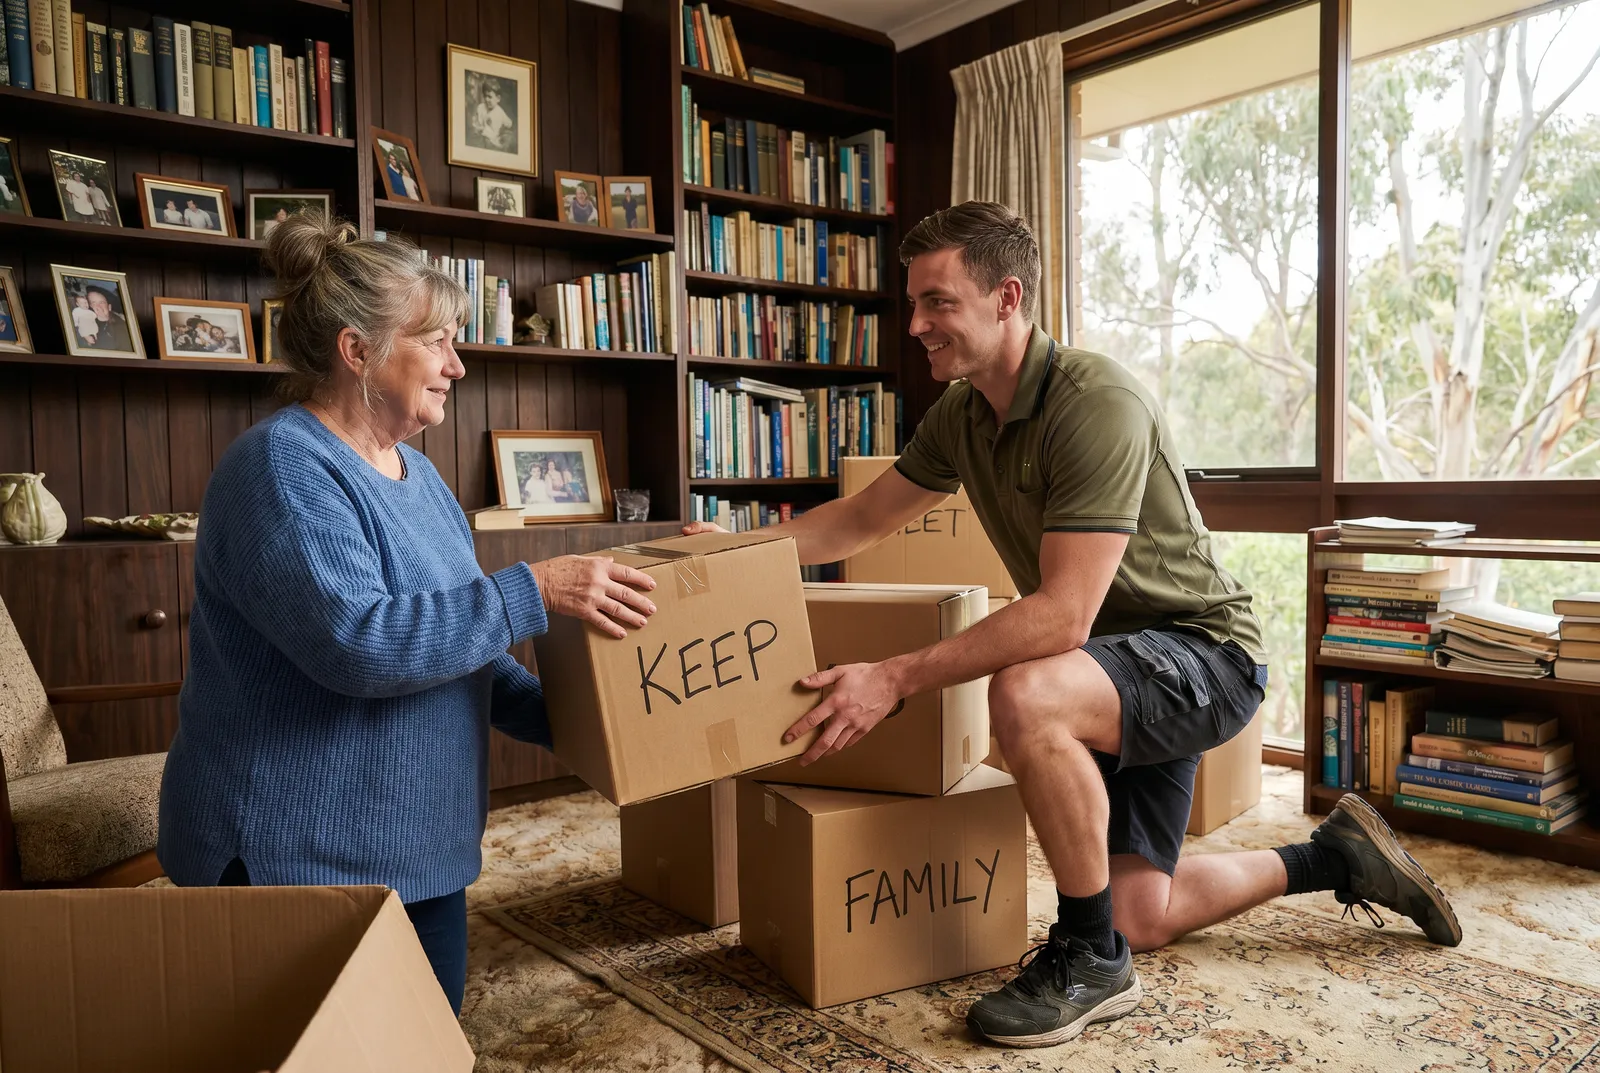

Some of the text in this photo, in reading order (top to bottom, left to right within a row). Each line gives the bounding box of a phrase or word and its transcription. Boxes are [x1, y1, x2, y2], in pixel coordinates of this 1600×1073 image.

[897, 508, 966, 538] ET
[637, 619, 778, 714] KEEP
[845, 849, 1000, 933] FAMILY
